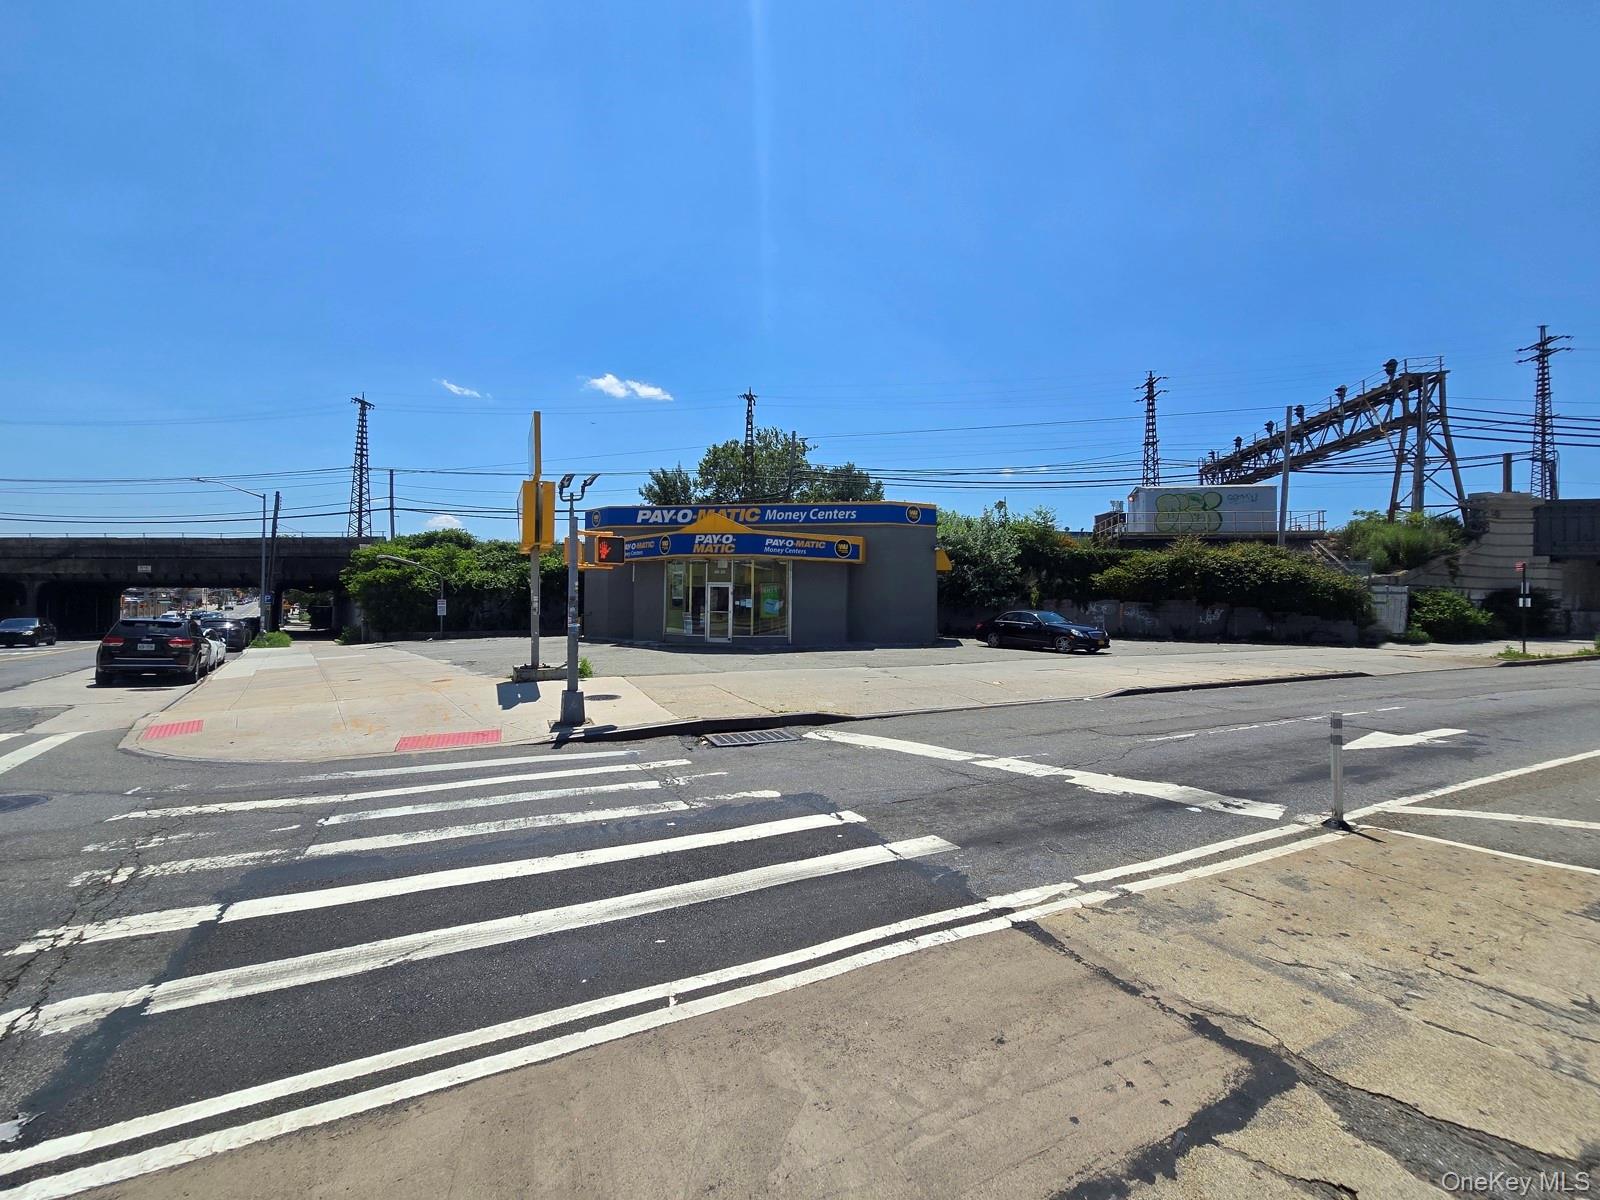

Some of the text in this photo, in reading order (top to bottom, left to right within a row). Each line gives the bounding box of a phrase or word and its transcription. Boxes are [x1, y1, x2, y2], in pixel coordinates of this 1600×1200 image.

[765, 509, 807, 523] Money
[809, 508, 857, 520] Centers
[693, 543, 736, 554] MATIC
[763, 546, 807, 555] Money Centers
